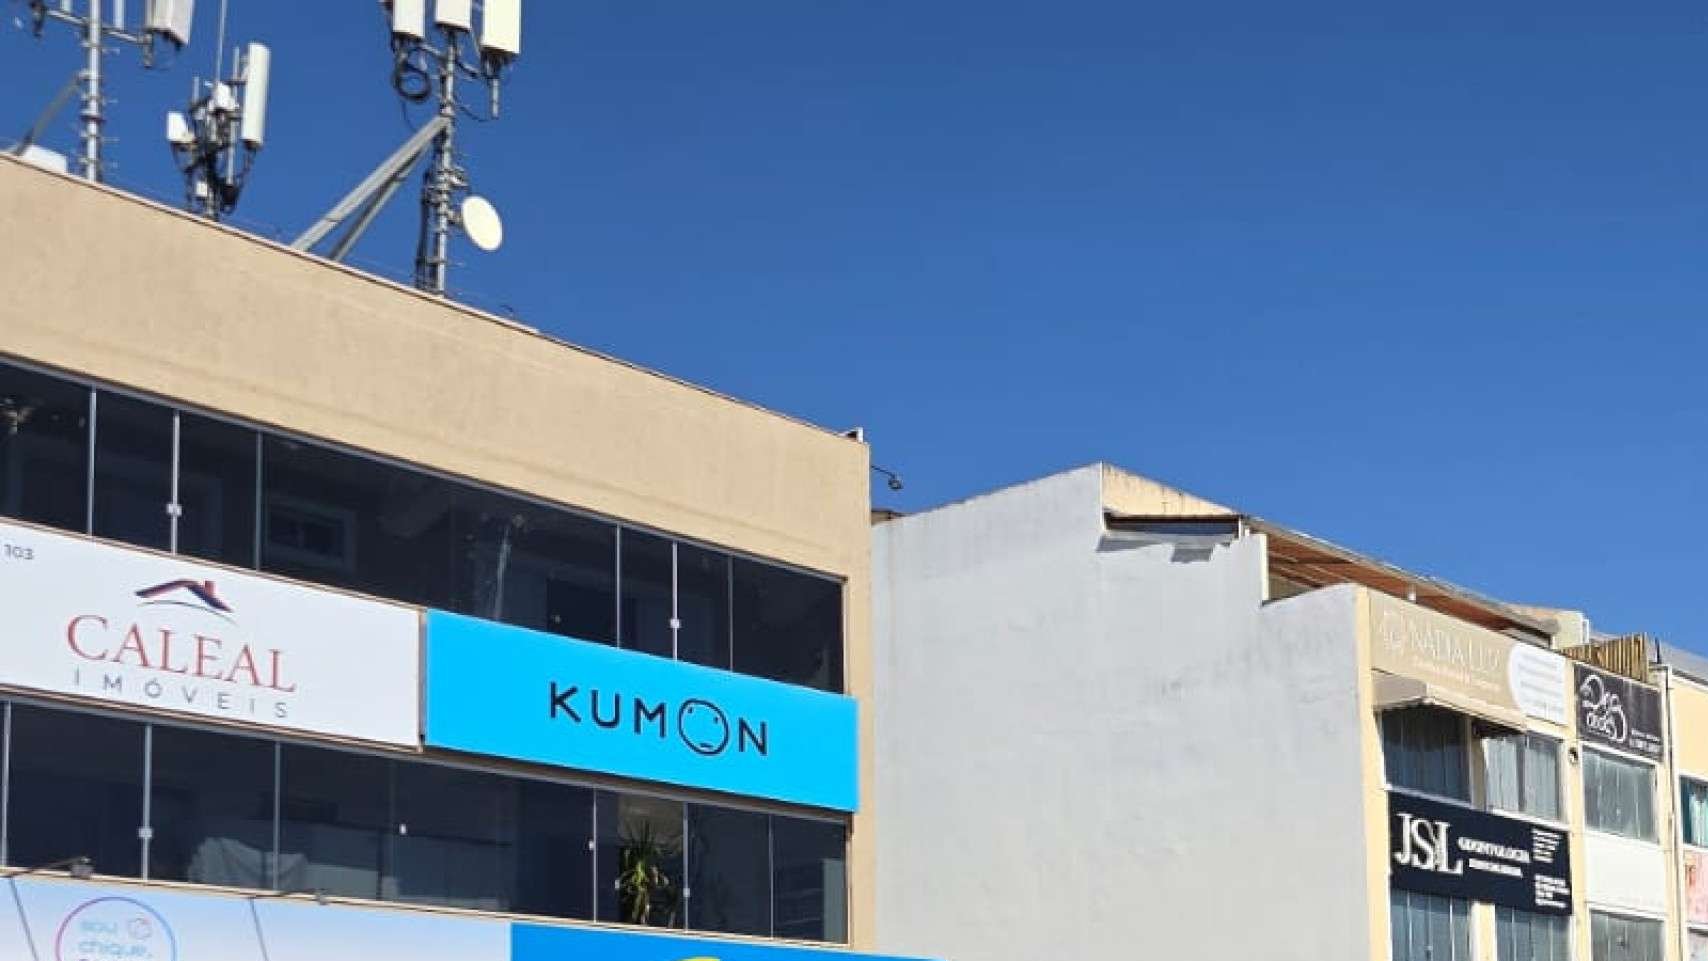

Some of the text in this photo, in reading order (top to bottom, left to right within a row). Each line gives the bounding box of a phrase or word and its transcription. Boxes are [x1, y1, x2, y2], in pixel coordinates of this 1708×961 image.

[66, 613, 297, 693] CALEAL
[73, 665, 288, 719] IMÓVEIS
[549, 680, 769, 756] KUMON
[1393, 812, 1463, 876] JSL
